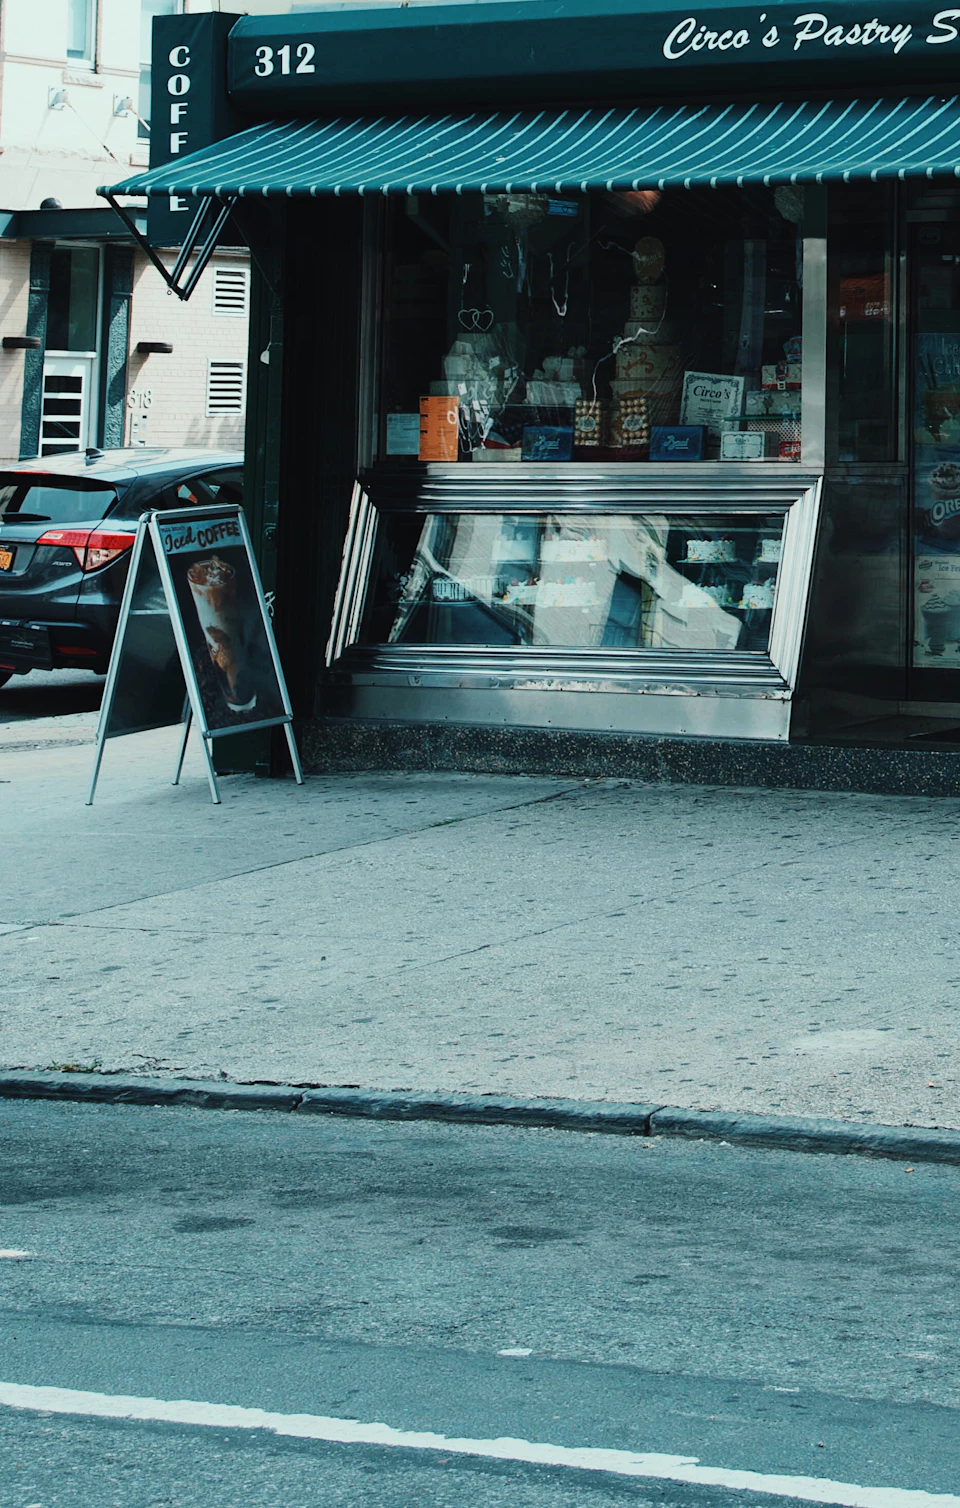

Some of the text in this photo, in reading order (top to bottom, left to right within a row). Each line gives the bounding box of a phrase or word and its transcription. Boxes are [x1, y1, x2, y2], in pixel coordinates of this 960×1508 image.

[662, 13, 780, 60] Circo's
[793, 13, 913, 54] Pastry
[254, 43, 316, 76] 312
[127, 389, 152, 409] 318
[693, 385, 731, 400] Circo's
[165, 521, 240, 552] Iced COFFEE
[938, 564, 949, 572] Ice
